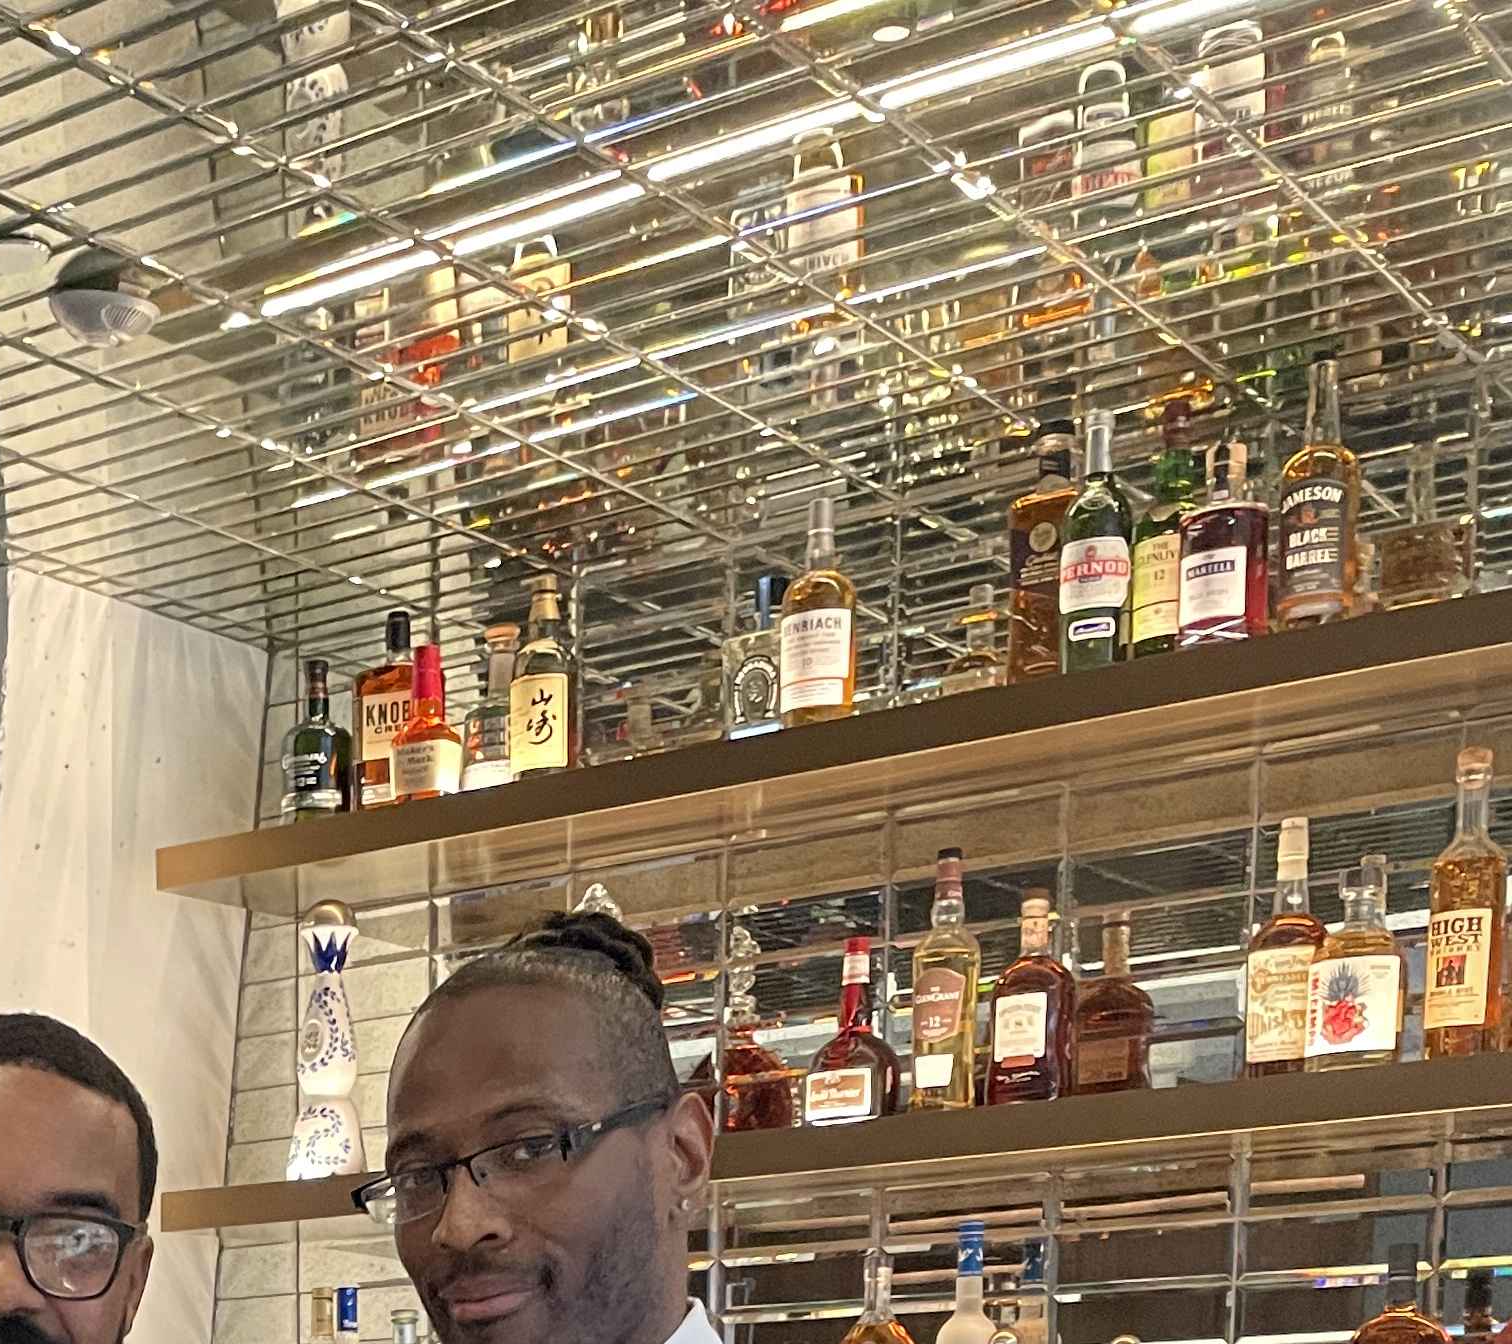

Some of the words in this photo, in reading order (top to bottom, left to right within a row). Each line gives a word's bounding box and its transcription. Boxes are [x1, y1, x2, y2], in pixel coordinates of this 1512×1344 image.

[1281, 485, 1343, 514] JAMESON
[1289, 527, 1329, 548] BLACK
[1188, 560, 1234, 578] MARTELL
[1286, 548, 1334, 570] BARREL
[1153, 568, 1166, 581] 12
[1431, 916, 1484, 936] HIGH
[1431, 933, 1483, 949] WEST
